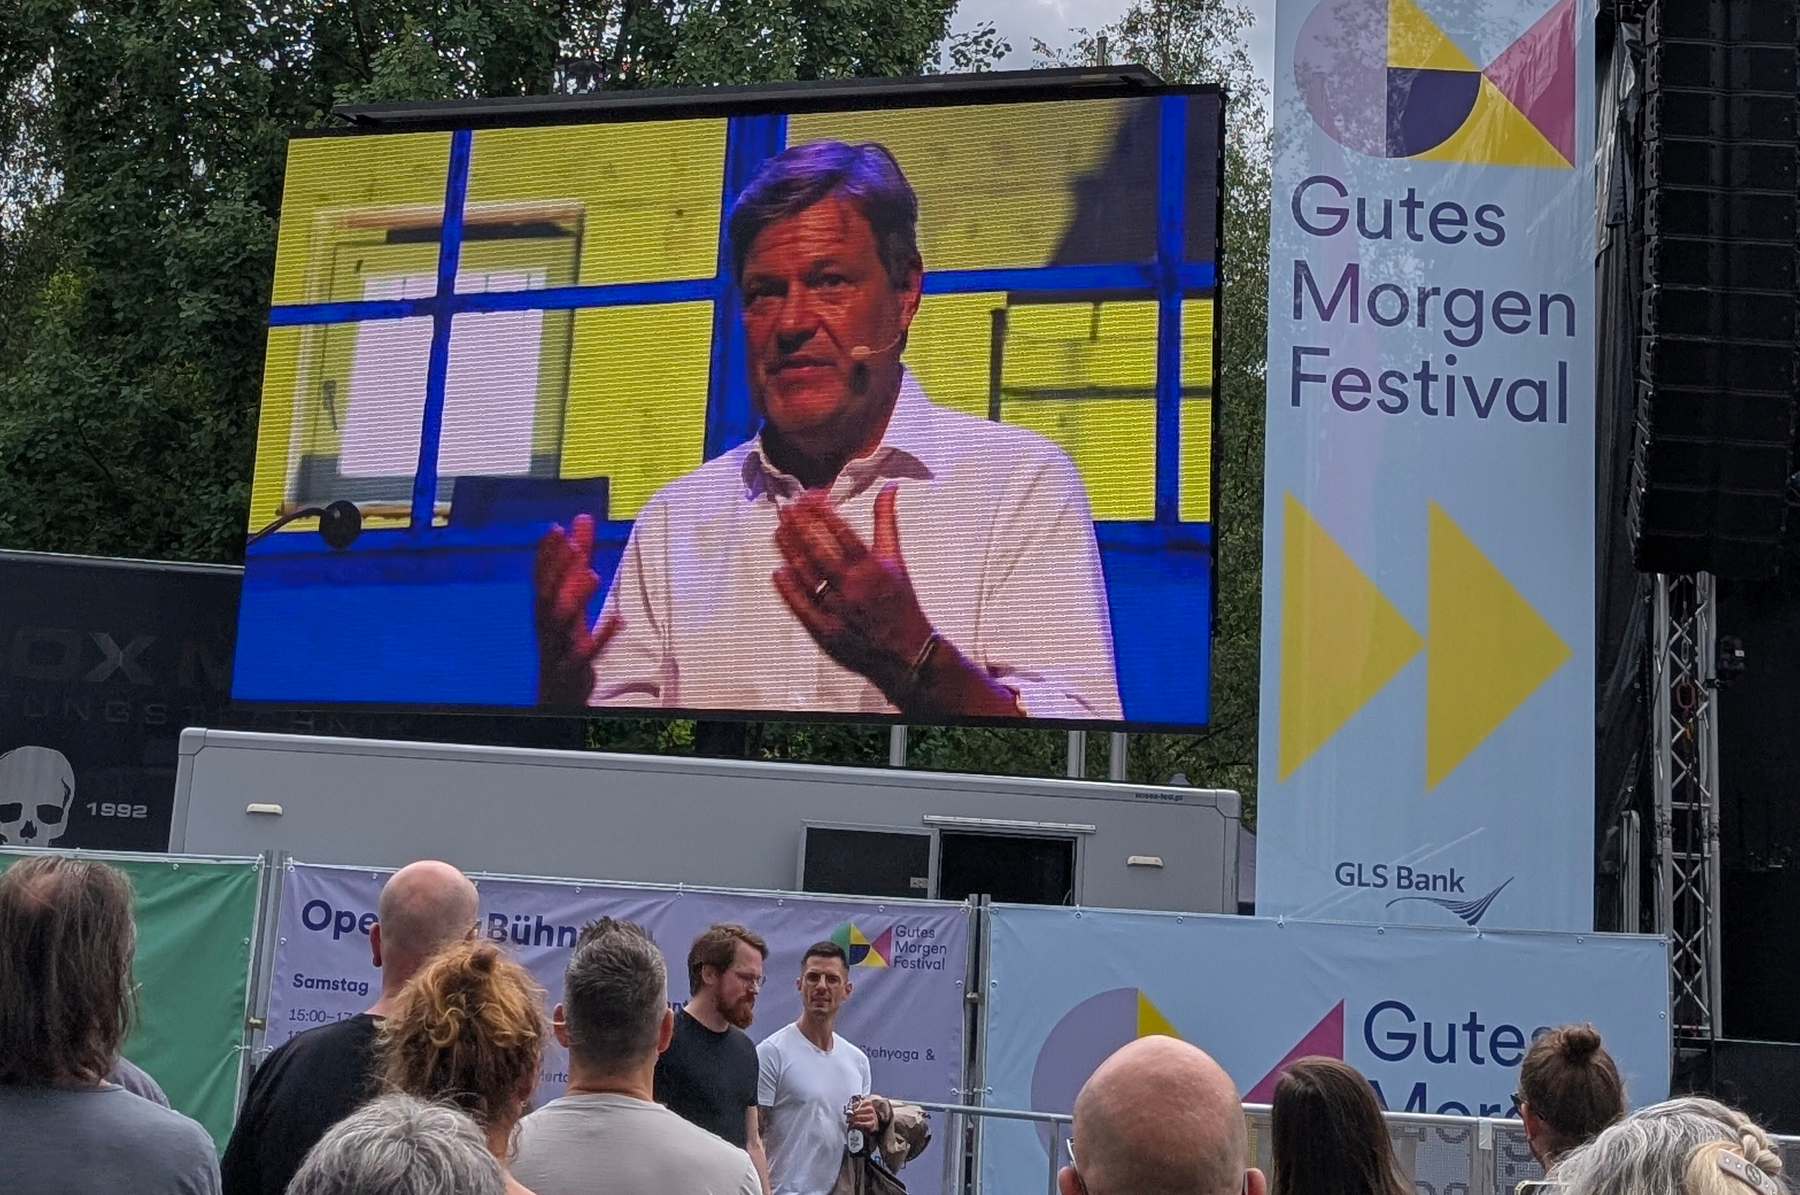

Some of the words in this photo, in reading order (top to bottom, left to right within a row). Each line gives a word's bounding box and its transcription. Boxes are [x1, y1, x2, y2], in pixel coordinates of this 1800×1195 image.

[1291, 175, 1506, 247] Gutes
[1292, 259, 1576, 348] Morgen
[1290, 345, 1568, 424] Festival
[86, 802, 148, 818] 1992
[1335, 862, 1388, 888] GLS
[1396, 865, 1465, 893] Bank
[302, 899, 379, 940] Ope
[487, 912, 577, 948] Bühn
[895, 924, 935, 939] Gutes
[895, 940, 947, 957] Morgen
[893, 955, 945, 971] Festival
[292, 973, 369, 996] Samstag
[925, 1048, 935, 1061] &
